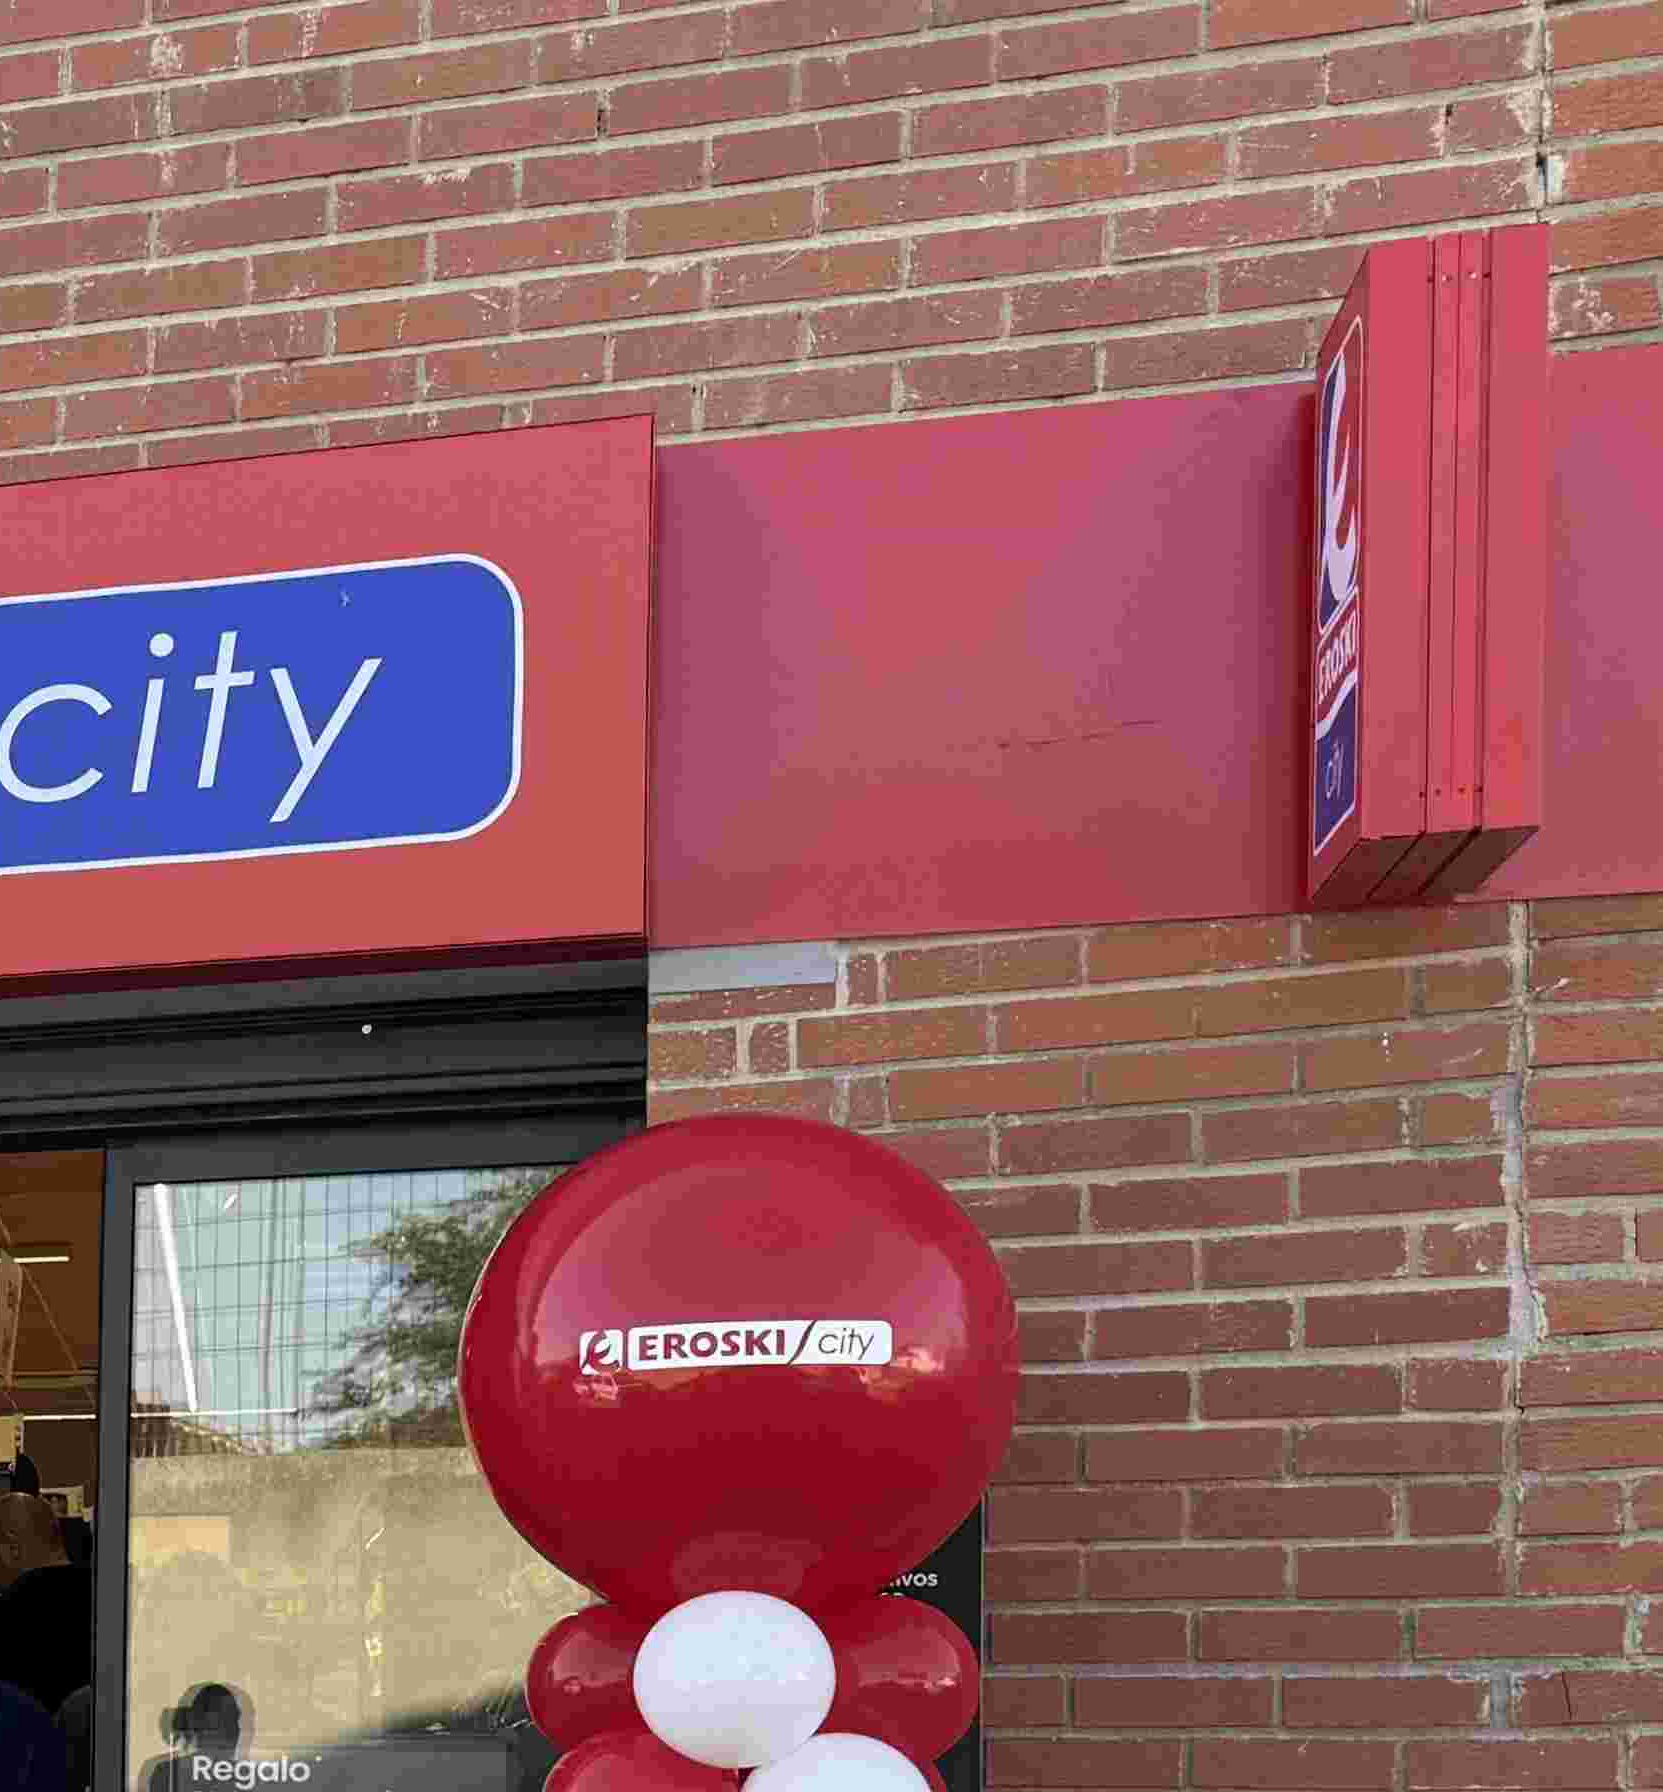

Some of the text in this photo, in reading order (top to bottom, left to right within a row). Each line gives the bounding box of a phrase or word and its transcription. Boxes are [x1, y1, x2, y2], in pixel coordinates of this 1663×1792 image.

[638, 1327, 875, 1361] EROSKI city
[191, 1754, 311, 1790] Regalo
